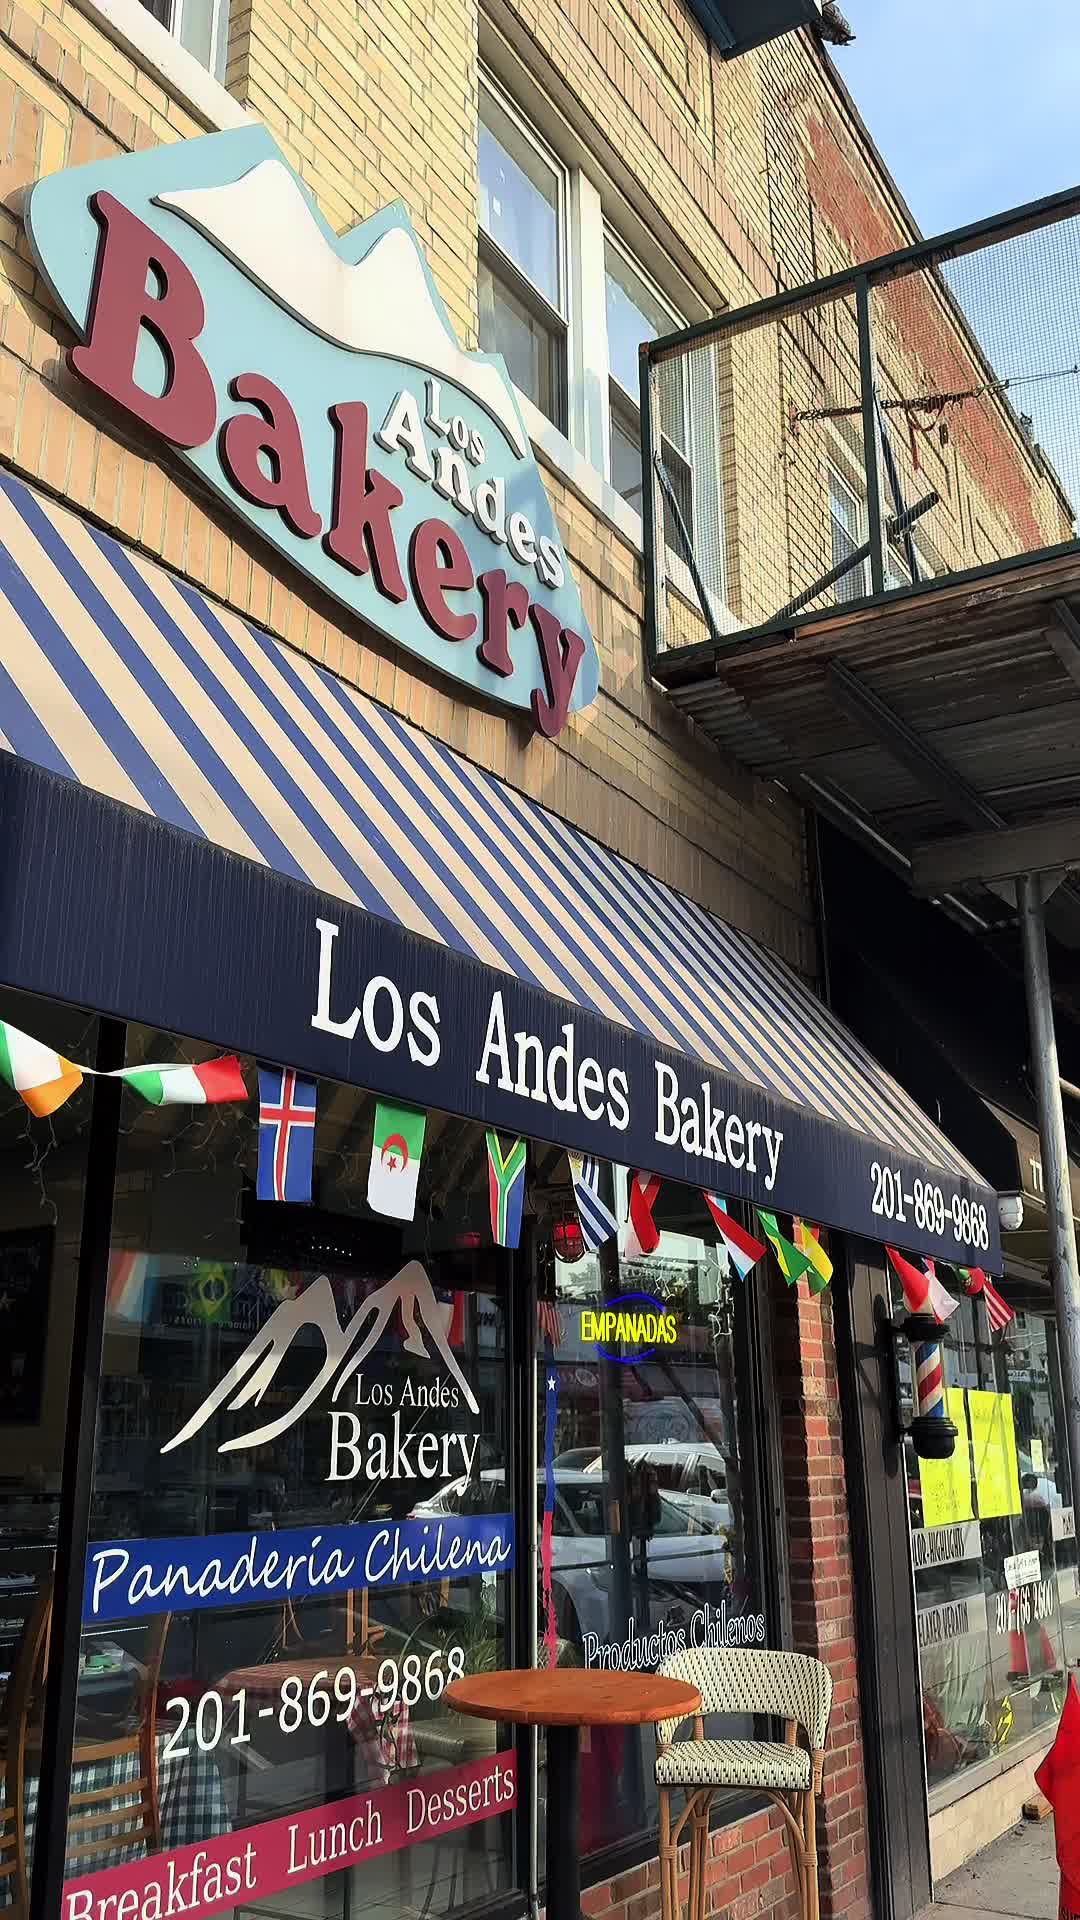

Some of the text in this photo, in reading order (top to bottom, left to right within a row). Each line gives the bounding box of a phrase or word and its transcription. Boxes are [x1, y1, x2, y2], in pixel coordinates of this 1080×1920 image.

[66, 189, 586, 738] Bakery
[424, 378, 486, 467] Los
[374, 389, 566, 590] Andes
[311, 917, 784, 1191] Los Andes Bakery
[870, 1161, 989, 1251] 201-869-9868
[581, 1311, 677, 1344] EMPANADAS
[355, 1373, 459, 1408] Los Andes
[324, 1410, 480, 1497] Bakery
[91, 1523, 512, 1613] Panadería Chilena
[582, 1599, 765, 1672] Productos Chilenos
[162, 1646, 466, 1760] 201-869-9868
[64, 1765, 516, 1920] Breakfast Lunch Desserts
